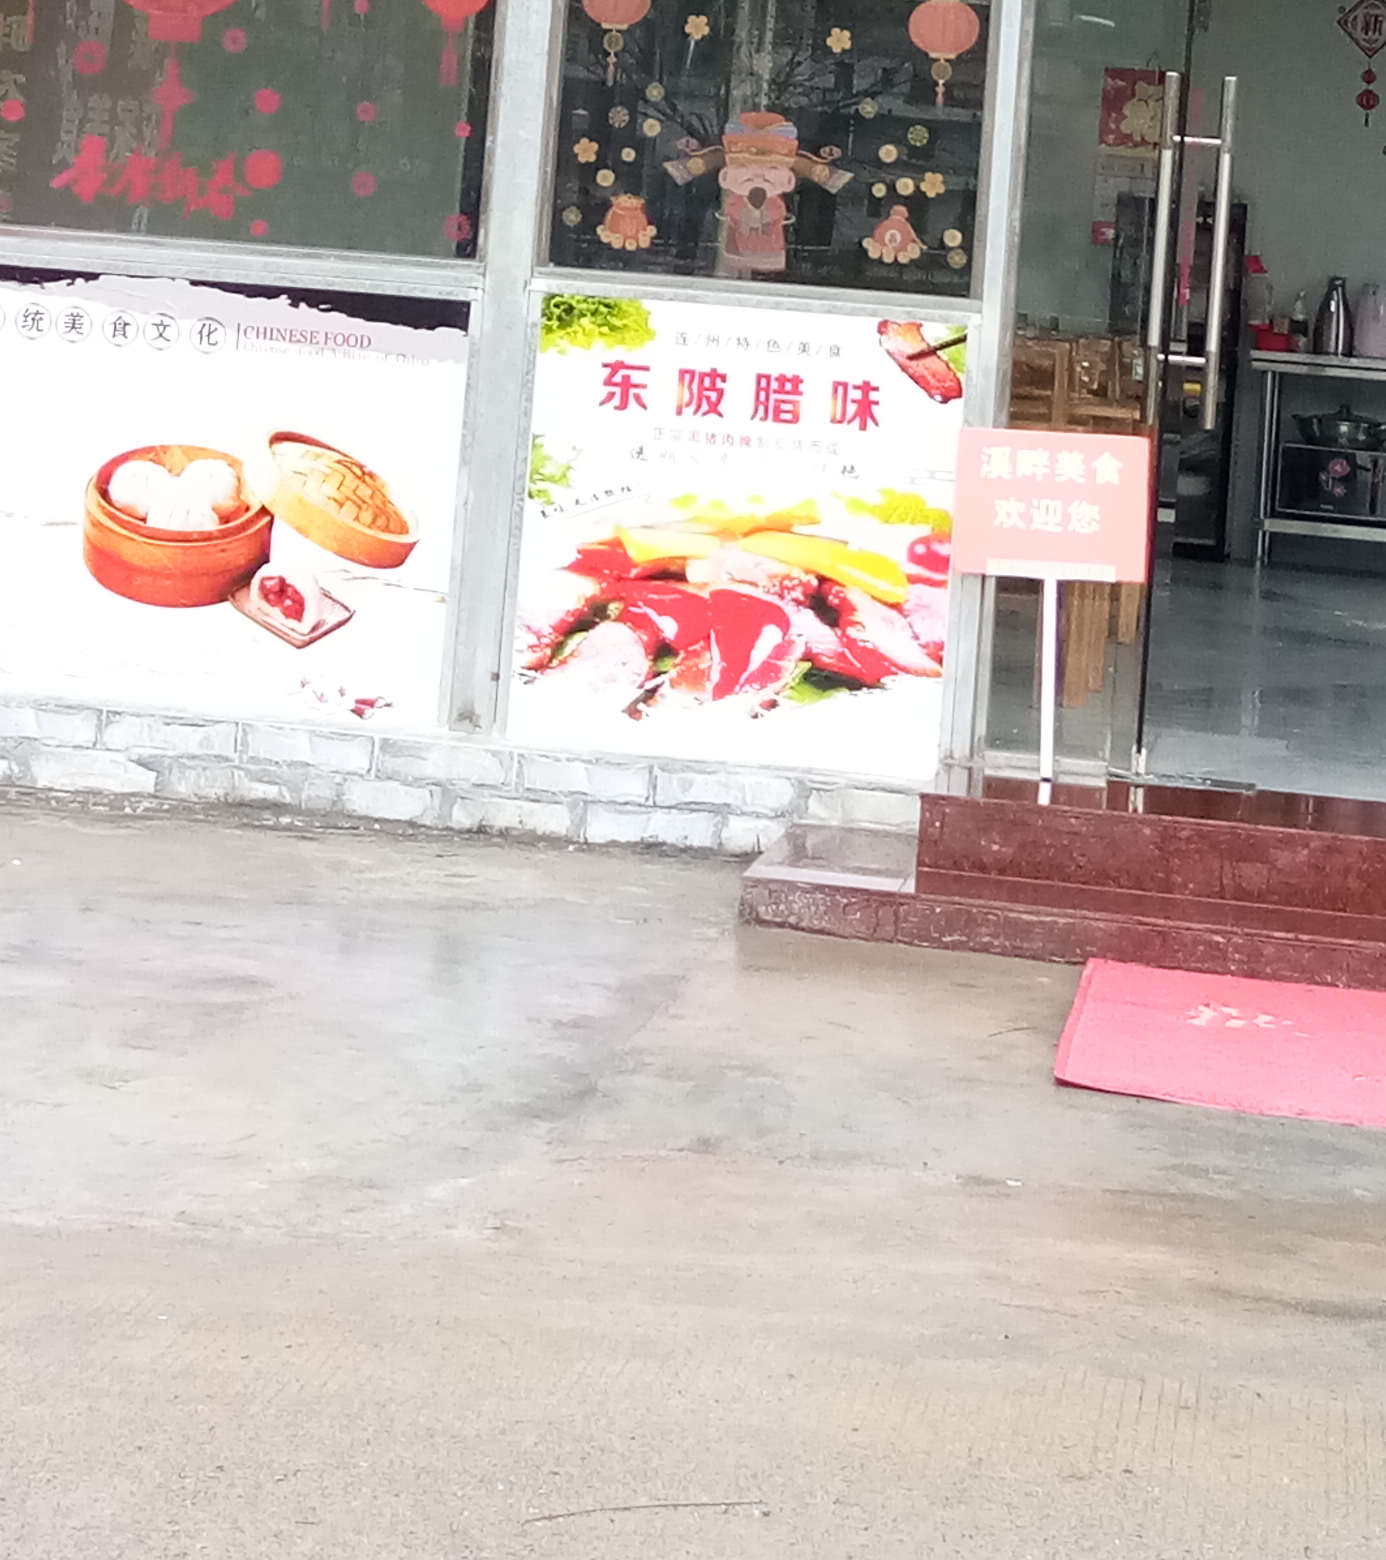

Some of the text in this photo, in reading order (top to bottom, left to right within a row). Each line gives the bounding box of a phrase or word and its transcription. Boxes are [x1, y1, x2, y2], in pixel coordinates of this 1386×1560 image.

[243, 324, 372, 349] CHINESE FOOD
[597, 359, 880, 431] 东陂腊味
[979, 446, 1124, 485] 溪畔美食
[992, 497, 1101, 534] 欢迎您
